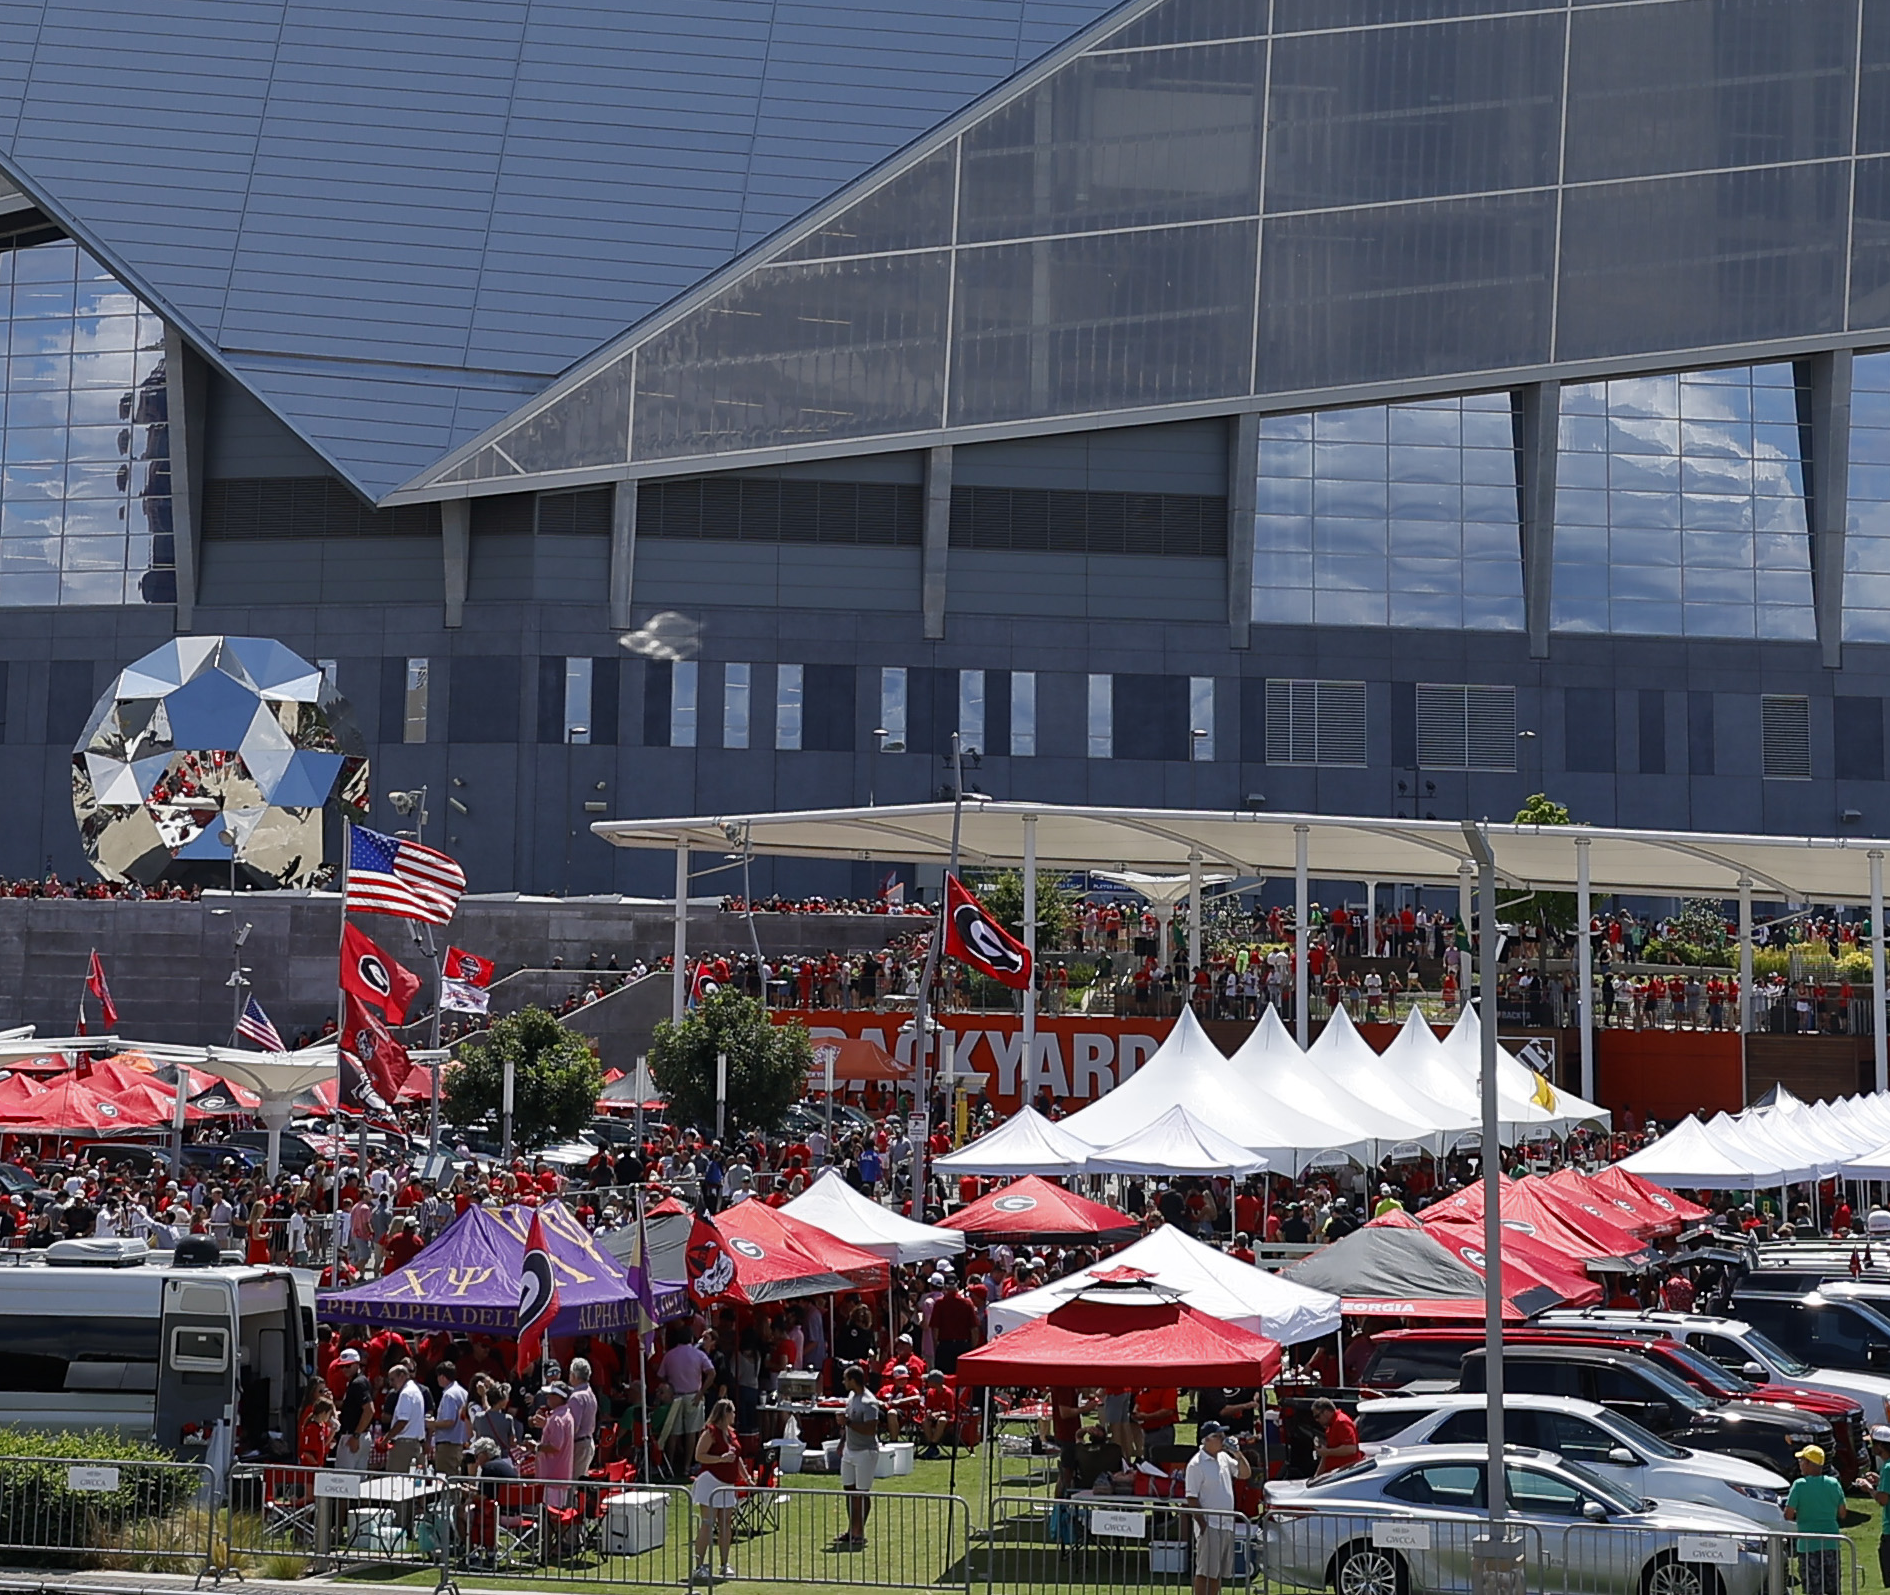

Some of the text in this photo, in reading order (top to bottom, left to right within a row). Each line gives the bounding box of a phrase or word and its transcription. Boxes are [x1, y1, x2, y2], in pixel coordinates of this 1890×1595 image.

[316, 1300, 520, 1328] LPHA ALPHA DELT
[578, 1302, 619, 1330] ALPHA
[1103, 1523, 1133, 1533] GWCCA
[1385, 1535, 1417, 1546] GWCCA
[1692, 1549, 1724, 1559] GWCCA
